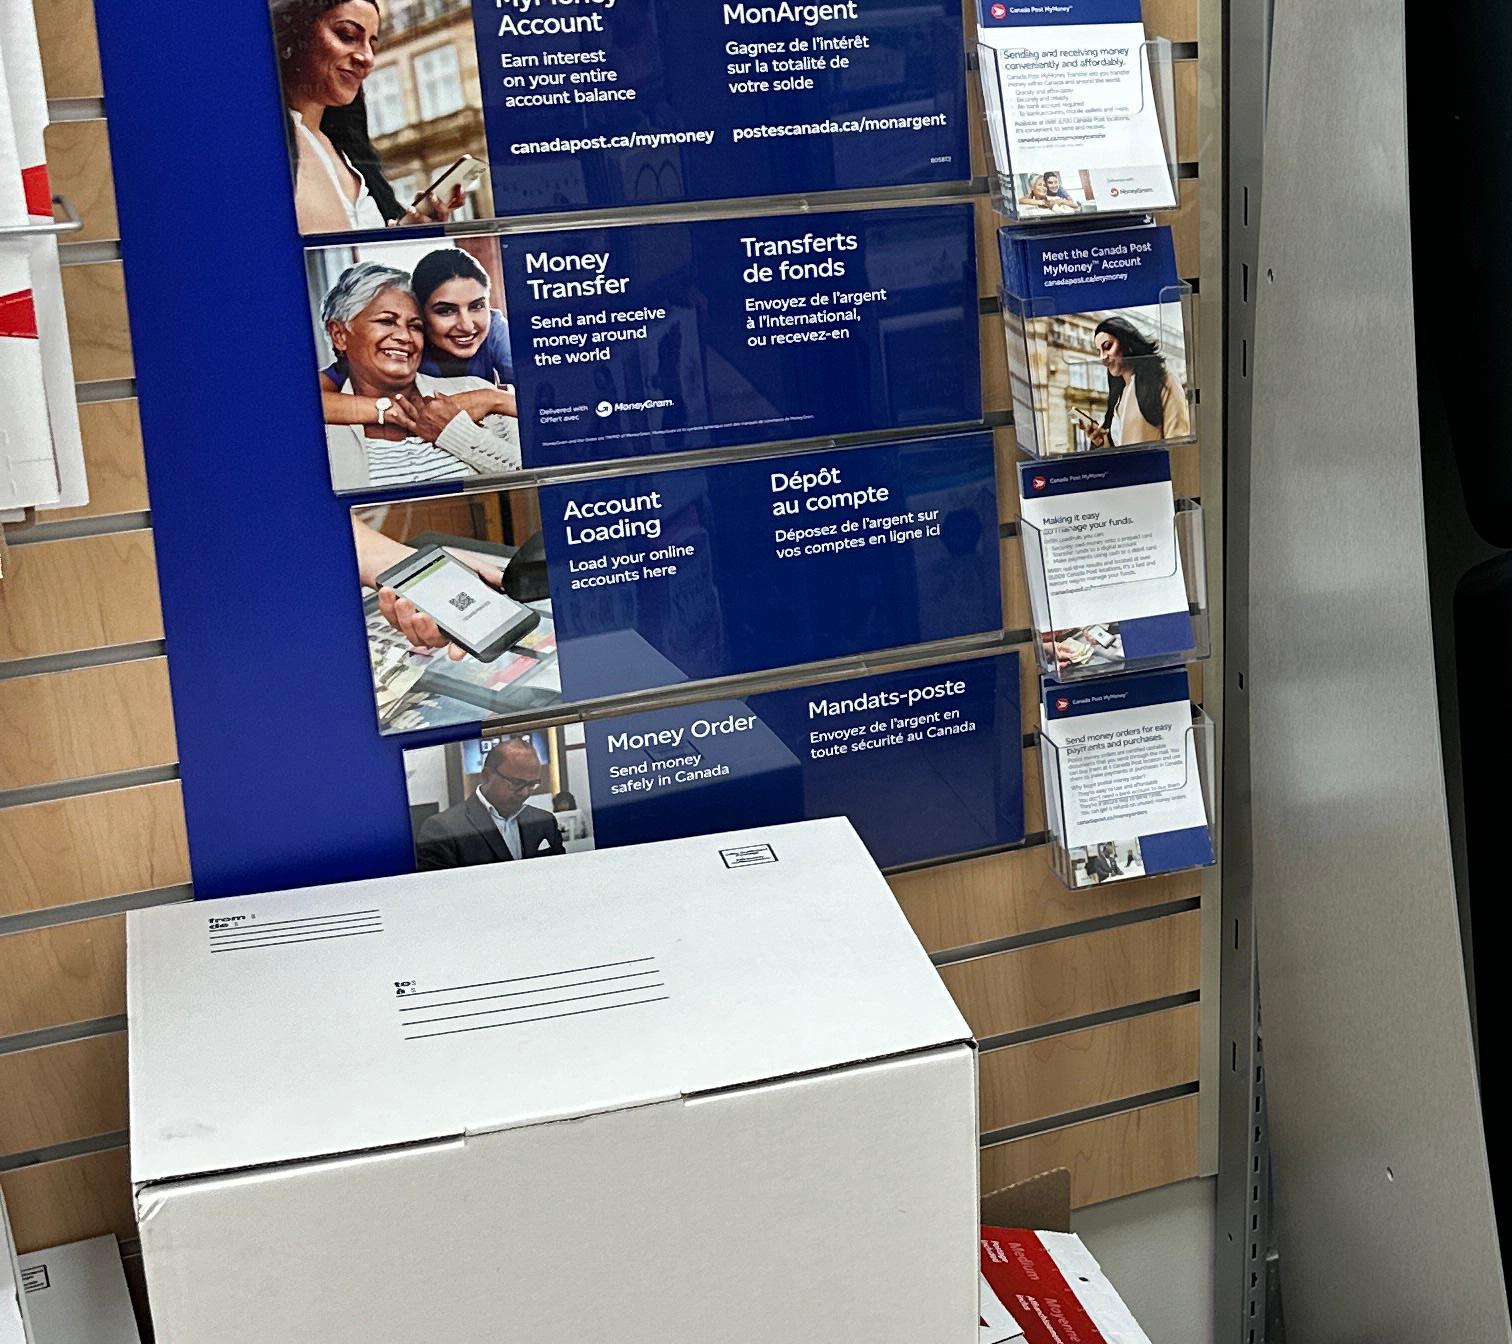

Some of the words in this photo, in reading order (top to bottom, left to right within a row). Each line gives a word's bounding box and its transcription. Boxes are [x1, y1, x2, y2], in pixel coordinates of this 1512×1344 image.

[723, 0, 858, 25] MonArgent
[498, 13, 603, 35] Account
[725, 40, 785, 57] Gagnez
[789, 37, 809, 51] de
[501, 54, 539, 67] Earn
[543, 50, 606, 65] interest
[726, 63, 751, 74] sur
[755, 58, 769, 72] la
[772, 55, 826, 72] totalité
[830, 55, 849, 69] de
[503, 76, 525, 87] on
[529, 74, 566, 89] your
[570, 69, 618, 83] entire
[728, 80, 769, 93] votre
[772, 75, 814, 91] solde
[505, 91, 570, 107] account
[575, 88, 636, 103] balance
[733, 113, 947, 142] postescanada.ca/monargent
[510, 132, 715, 154] canadapost.ca/mymoney
[740, 233, 858, 258] Transferts
[1042, 251, 1069, 262] Meet
[1071, 248, 1089, 259] the
[1091, 244, 1128, 256] Canada
[1130, 242, 1152, 252] Post
[526, 253, 610, 273] Money
[742, 262, 773, 283] de
[779, 256, 846, 280] fonds
[1102, 257, 1142, 269] Account
[527, 275, 630, 301] Transfer
[745, 297, 806, 312] Envoyez
[810, 292, 830, 306] de
[833, 288, 887, 305] l'argent
[531, 312, 574, 329] Send
[577, 310, 608, 325] and
[611, 307, 666, 323] receive
[746, 314, 755, 328] à
[532, 334, 588, 348] money
[591, 325, 647, 343] around
[747, 336, 767, 347] ou
[771, 329, 850, 345] recevez-en
[534, 351, 562, 366] the
[565, 346, 611, 363] world
[771, 467, 842, 494] Dépôt
[563, 491, 662, 520] Account
[772, 500, 800, 515] au
[806, 486, 889, 511] compte
[566, 518, 661, 545] Loading
[809, 679, 966, 719] Mandats-poste
[607, 728, 684, 753] Money
[691, 715, 757, 739] Order
[1066, 735, 1085, 744] Send
[1087, 732, 1114, 741] money
[1116, 728, 1140, 736] orders
[1008, 1242, 1040, 1281] Medium
[1044, 1297, 1081, 1342] Moyenne
